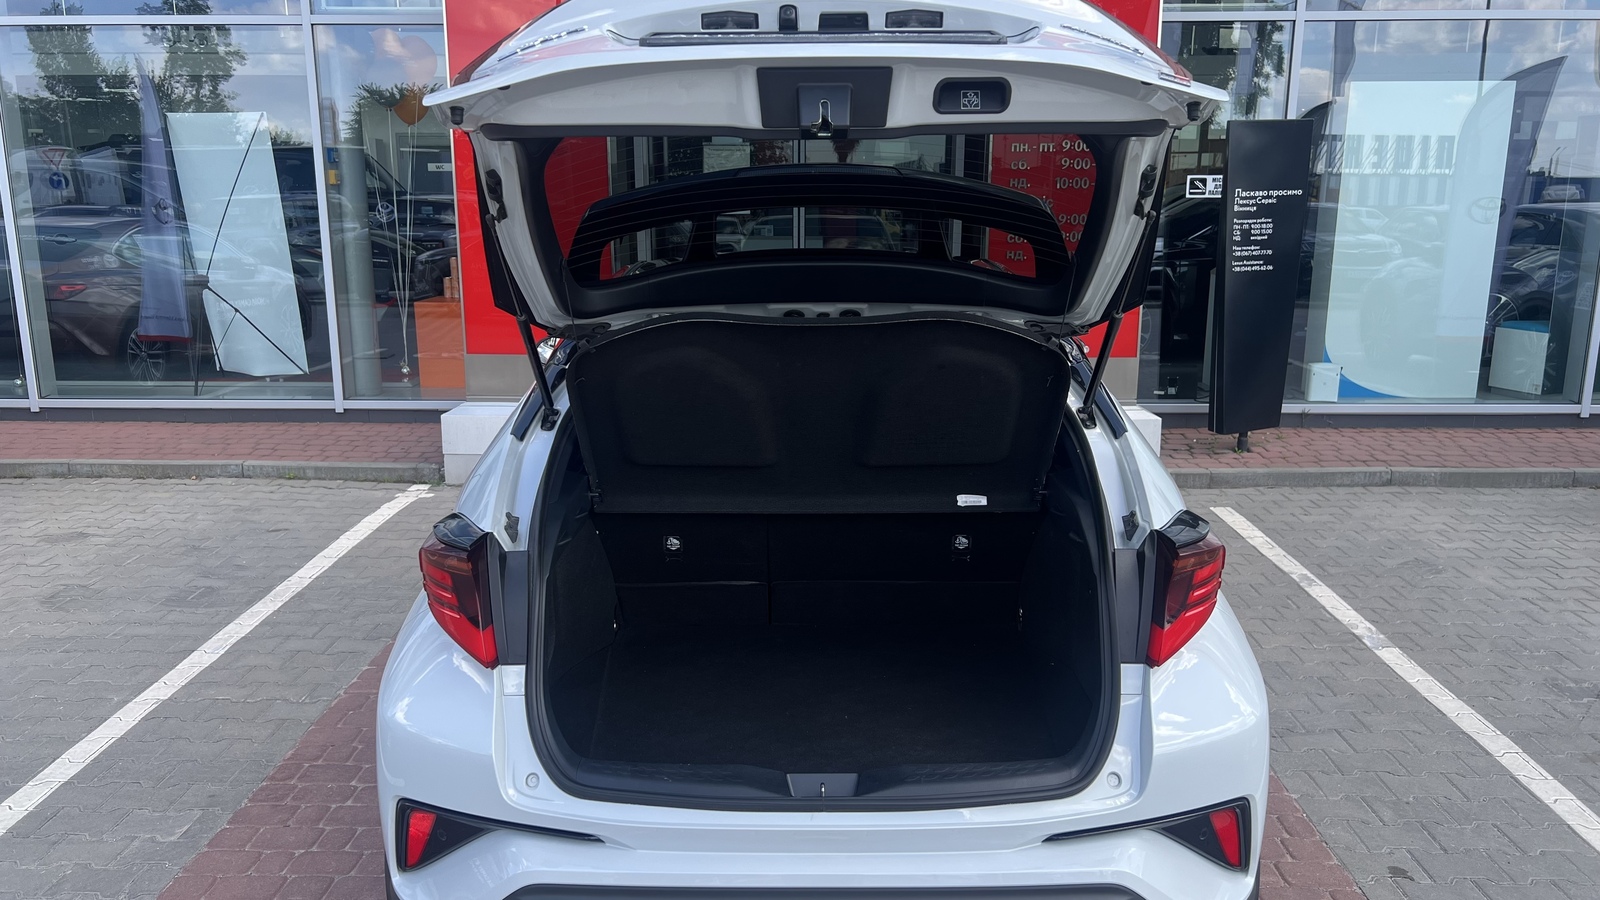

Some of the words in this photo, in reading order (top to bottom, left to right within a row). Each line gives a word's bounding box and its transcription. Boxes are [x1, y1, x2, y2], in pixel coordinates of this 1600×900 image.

[1011, 158, 1031, 170] сб.
[1009, 178, 1031, 189] нд.
[1234, 188, 1268, 197] Ласкаво
[1268, 189, 1303, 198] просимо
[1234, 197, 1256, 205] Лексус
[1006, 250, 1027, 261] нд.
